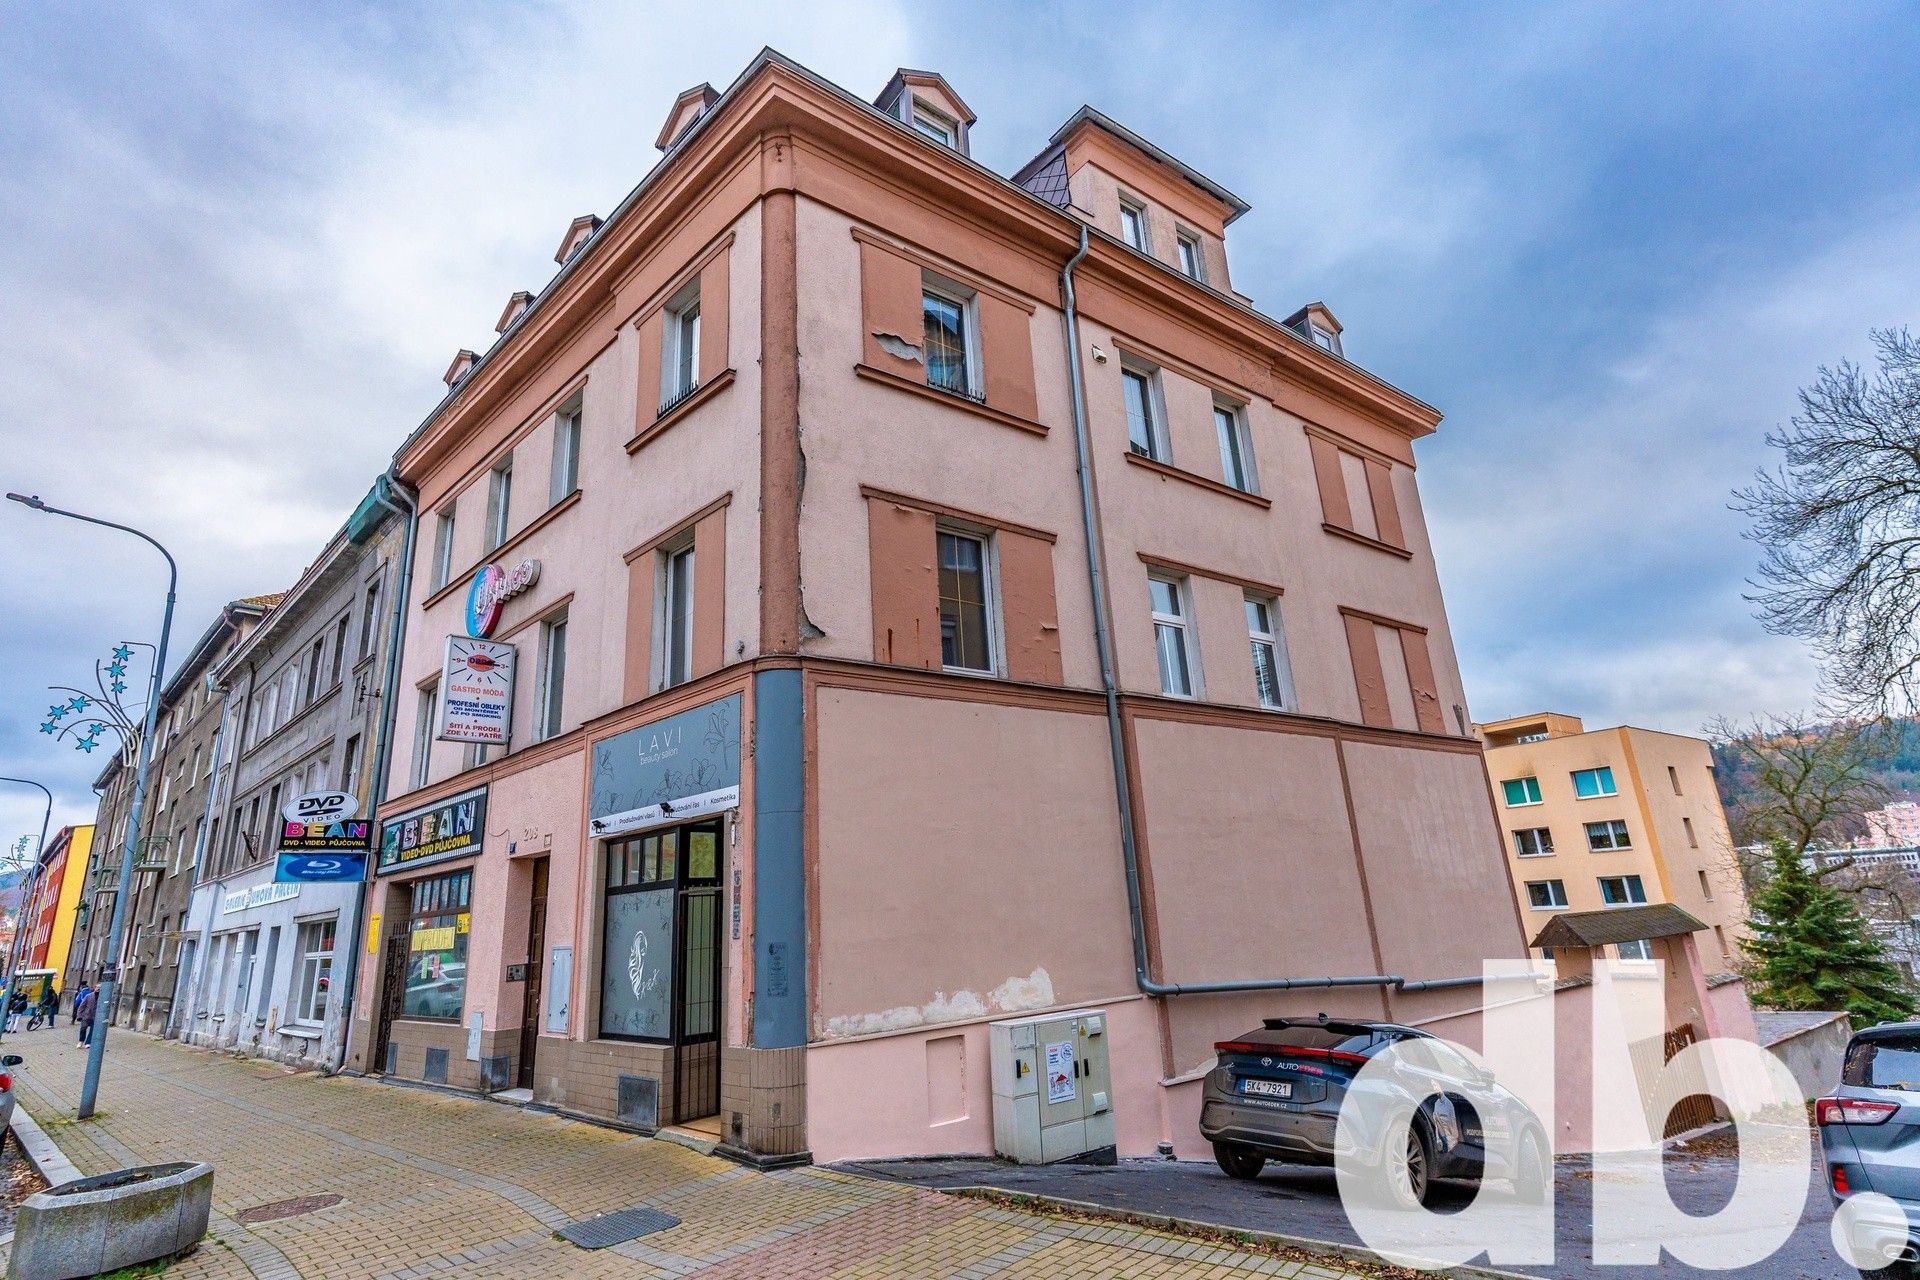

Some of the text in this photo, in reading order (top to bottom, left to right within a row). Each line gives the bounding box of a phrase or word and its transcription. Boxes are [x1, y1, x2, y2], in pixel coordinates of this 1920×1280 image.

[451, 685, 481, 694] GASTRO
[447, 699, 506, 711] PROFESNÍ OBLEKY
[473, 725, 501, 733] PRODEJ
[479, 732, 503, 740] PATŘE
[638, 726, 682, 757] LAVI
[661, 746, 679, 760] salon
[298, 795, 345, 810] DVD
[710, 794, 736, 805] Kosmetika
[303, 814, 342, 823] VIDEO
[284, 821, 368, 838] BEAN
[401, 800, 476, 852] BEAN
[434, 834, 471, 853] PŮJČOVNA
[1246, 1080, 1288, 1095] 5K4 7921
